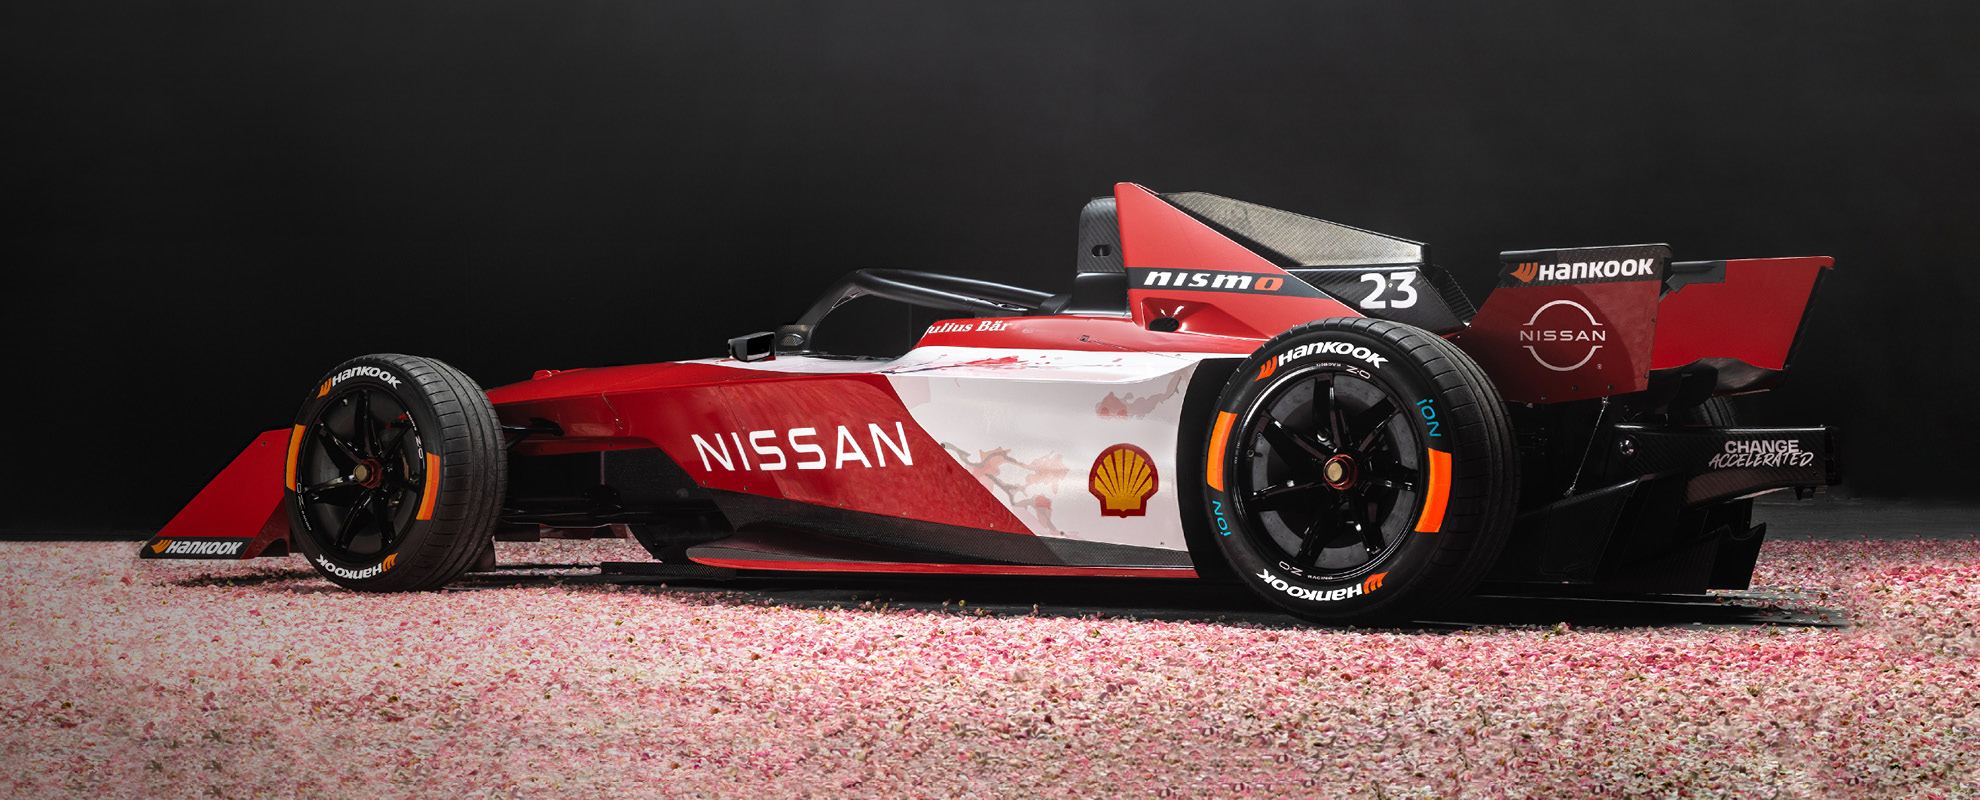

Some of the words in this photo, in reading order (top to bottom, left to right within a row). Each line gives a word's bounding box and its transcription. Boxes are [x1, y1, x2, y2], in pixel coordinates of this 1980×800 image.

[1143, 271, 1284, 291] nismo
[1359, 271, 1418, 310] 23
[975, 320, 1012, 332] Bär
[1519, 330, 1606, 342] NISSAN
[690, 421, 914, 472] NISSAN
